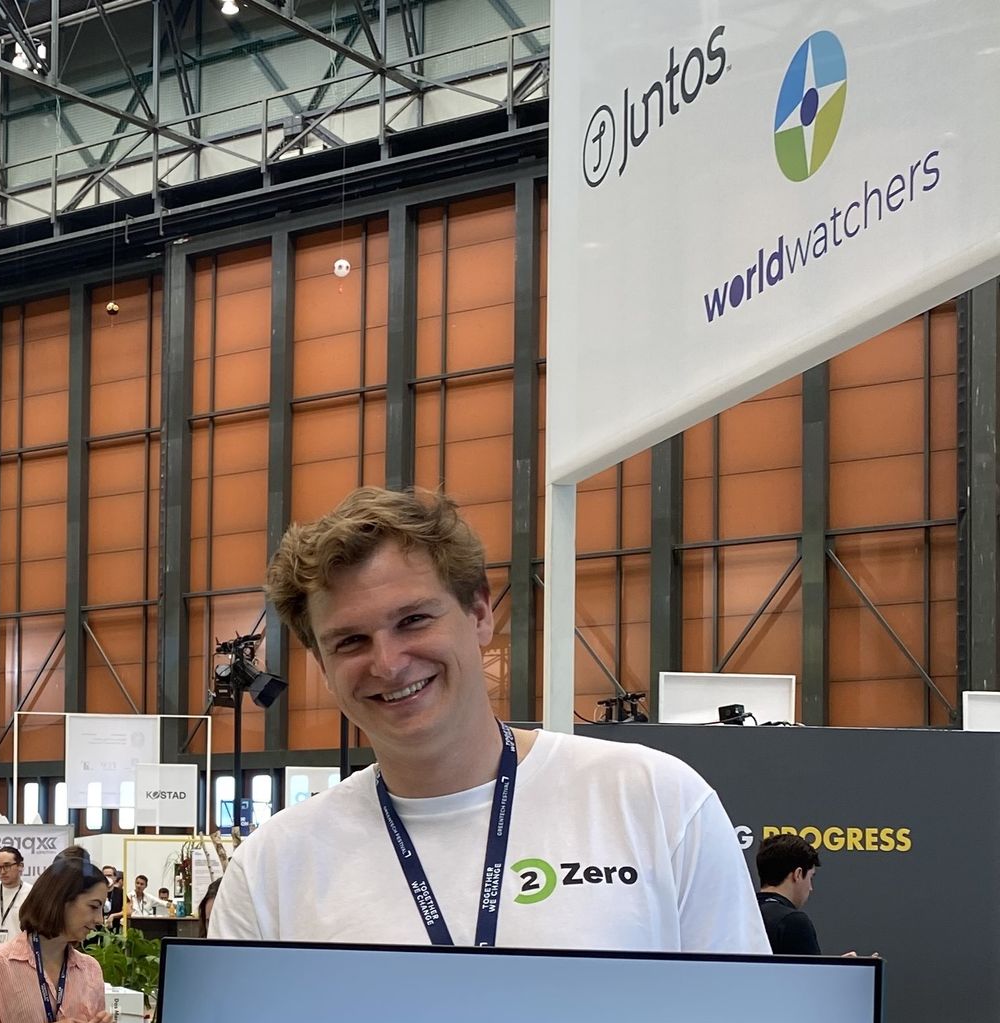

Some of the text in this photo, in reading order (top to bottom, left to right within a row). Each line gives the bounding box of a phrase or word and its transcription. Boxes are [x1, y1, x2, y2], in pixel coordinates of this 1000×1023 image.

[619, 25, 727, 177] Juntos
[704, 150, 941, 323] worldwatchers
[497, 782, 509, 836] GREENTECH FESTIVAL
[396, 832, 407, 855] FESTIVAL
[481, 867, 494, 909] TOGETHER
[489, 863, 501, 913] WE CHANGE
[520, 862, 638, 892] 2 Zero
[411, 881, 434, 926] WE CHANGE
[418, 880, 439, 920] TOGETHER
